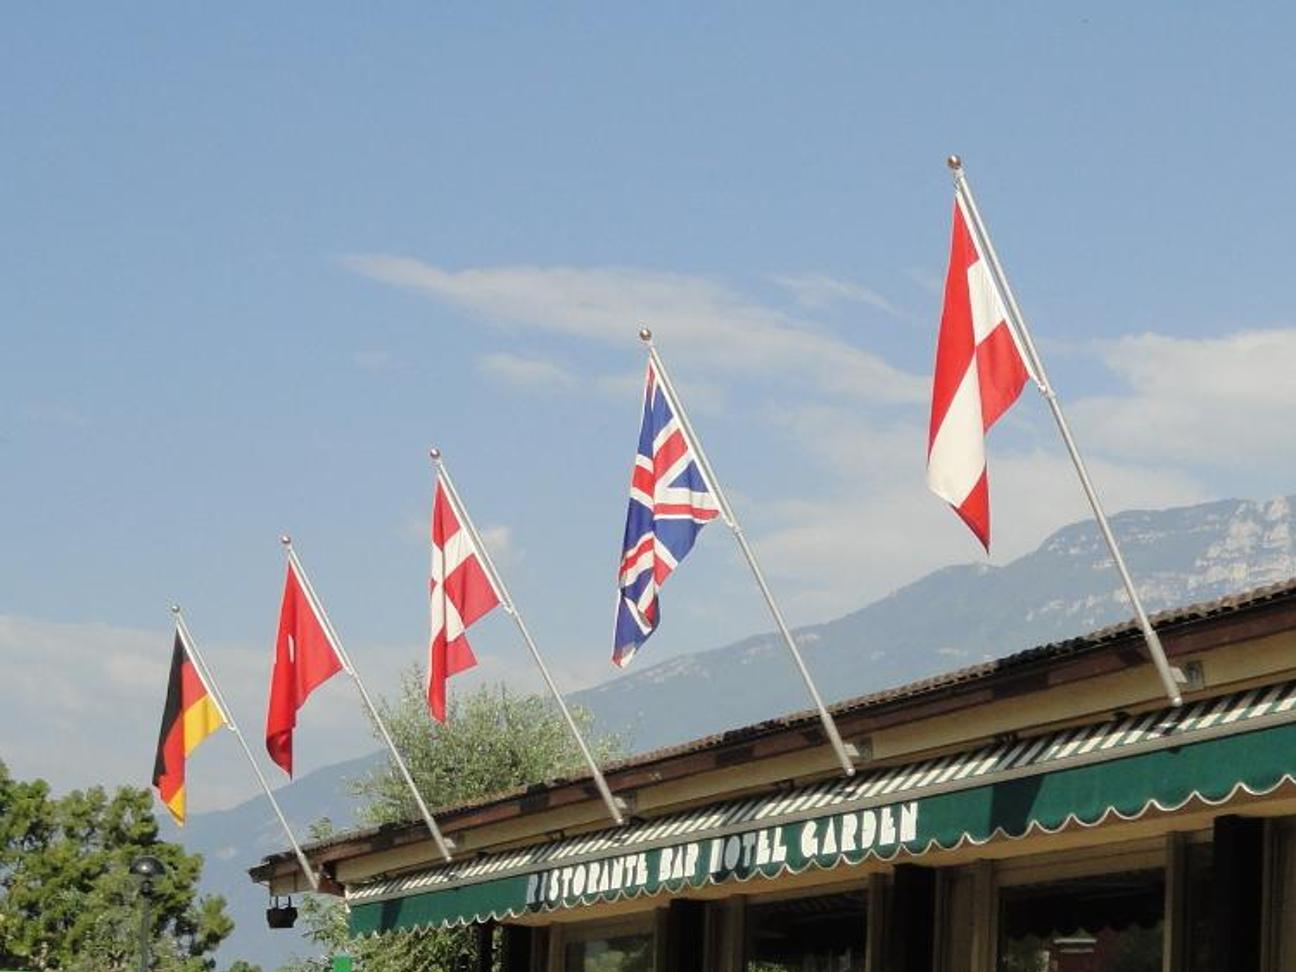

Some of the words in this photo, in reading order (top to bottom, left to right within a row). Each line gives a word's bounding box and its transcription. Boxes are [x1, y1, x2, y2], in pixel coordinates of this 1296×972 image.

[526, 853, 648, 904] RISTORANTE
[658, 843, 699, 881] BAR
[709, 827, 787, 873] HOTEL
[801, 801, 918, 858] GARDEN
